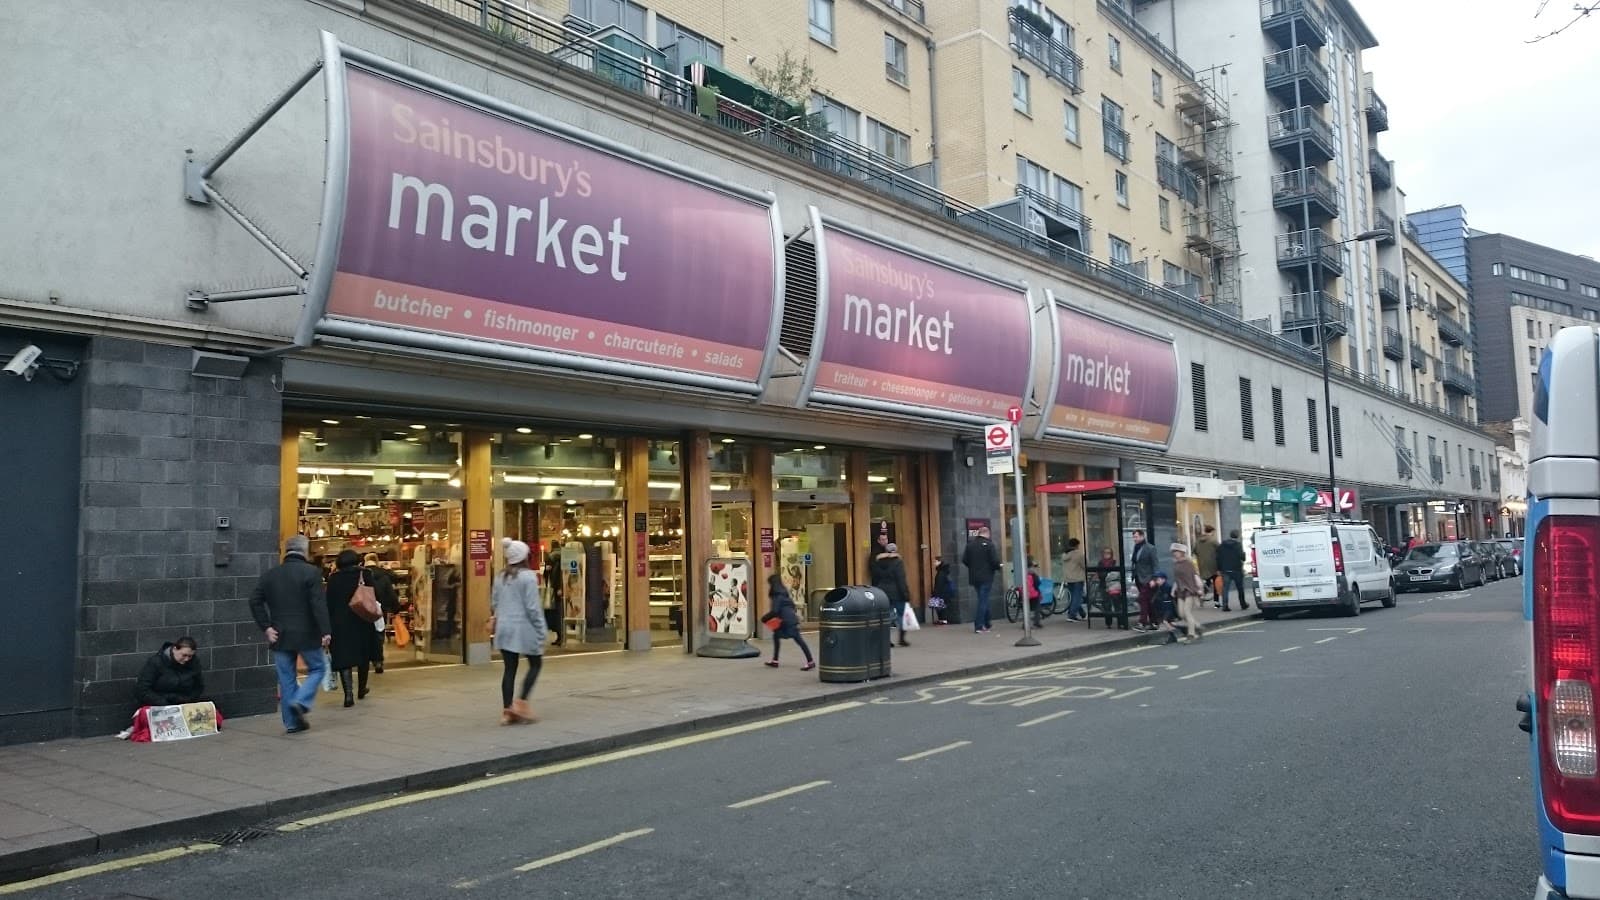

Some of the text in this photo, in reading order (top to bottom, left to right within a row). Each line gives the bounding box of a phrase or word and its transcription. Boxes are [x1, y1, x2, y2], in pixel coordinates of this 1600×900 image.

[392, 104, 593, 198] Sainsbury's
[388, 172, 630, 281] market
[374, 290, 744, 369] butcher fishmonger charcuterie salads
[843, 293, 954, 355] market
[834, 371, 869, 388] traiteur
[881, 381, 938, 401] cheesemonger
[1066, 353, 1132, 396] market
[1010, 408, 1019, 421] T
[1003, 664, 1179, 680] BUS
[870, 685, 1115, 707] STOP
